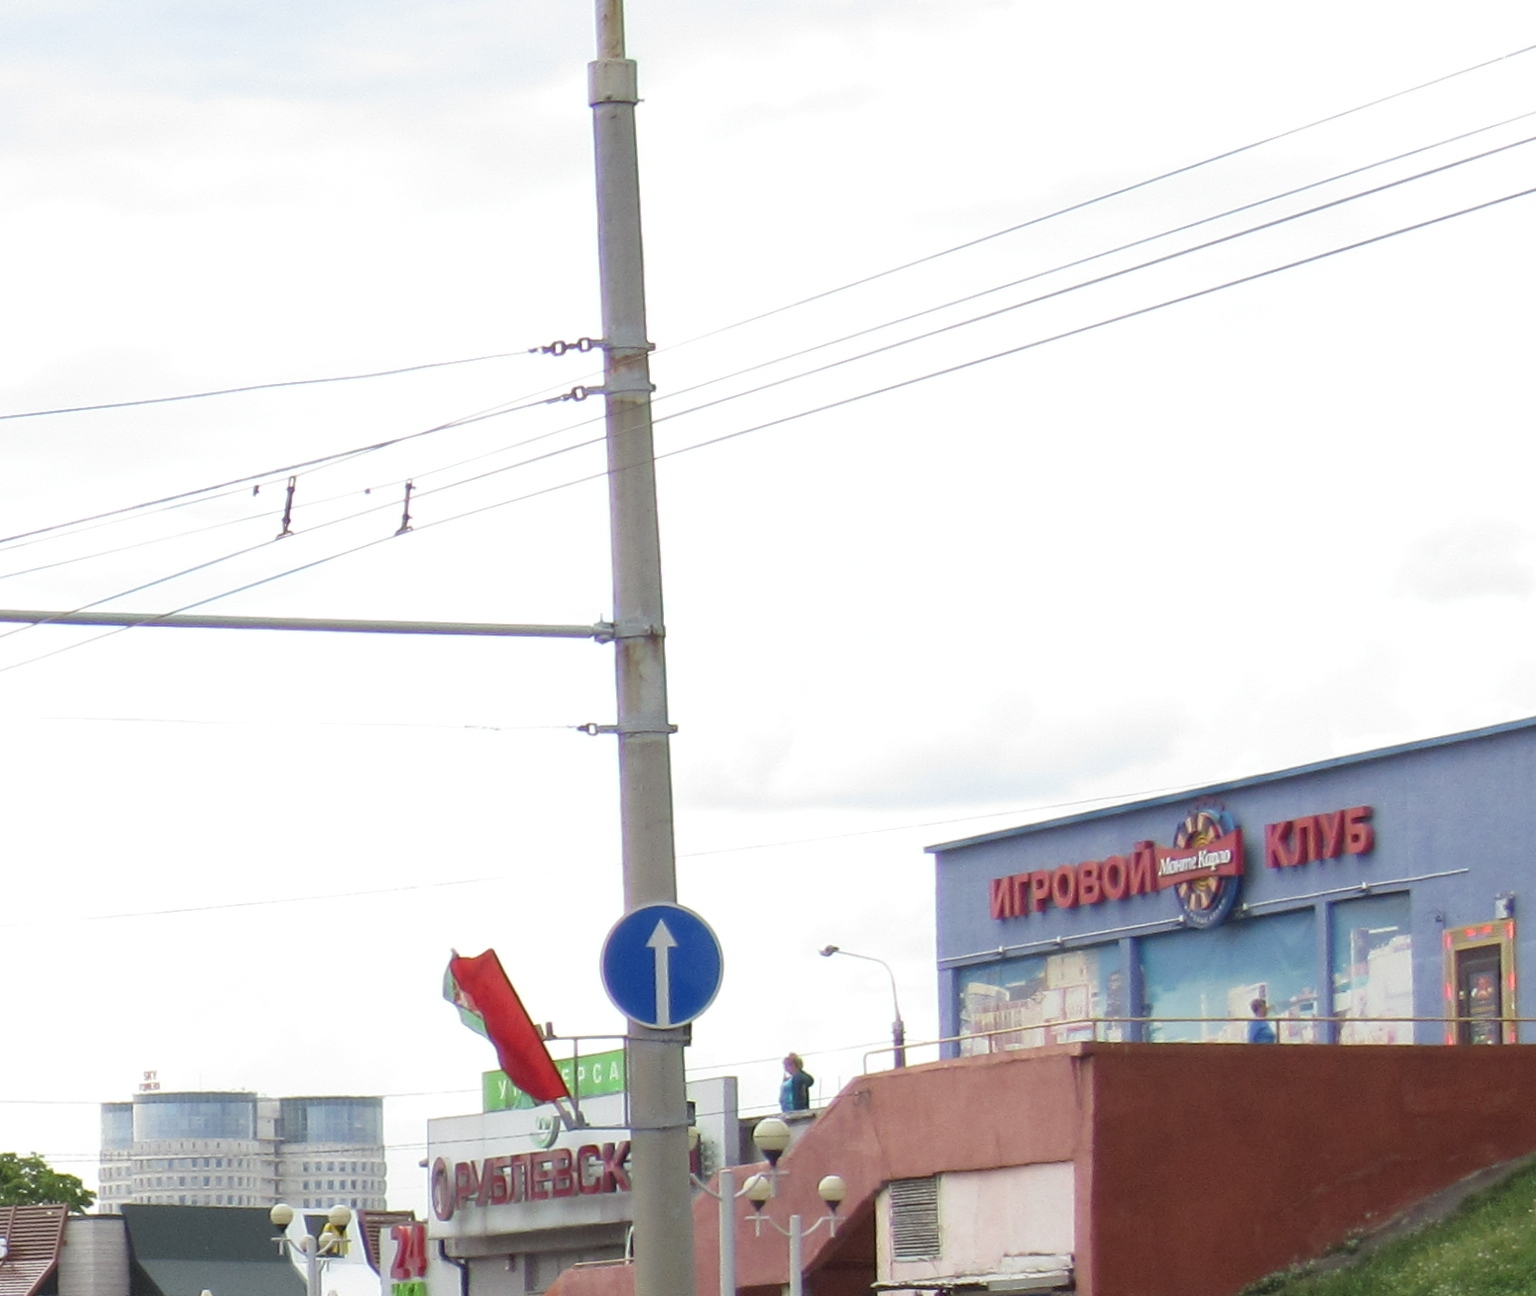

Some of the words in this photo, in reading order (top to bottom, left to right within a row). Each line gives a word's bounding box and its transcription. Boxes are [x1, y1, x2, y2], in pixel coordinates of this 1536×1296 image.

[990, 841, 1157, 920] ИГРОВОЙ
[1265, 805, 1376, 869] КЛУБ
[454, 1138, 701, 1211] РУБЛЕВСК
[391, 1224, 429, 1280] 24
